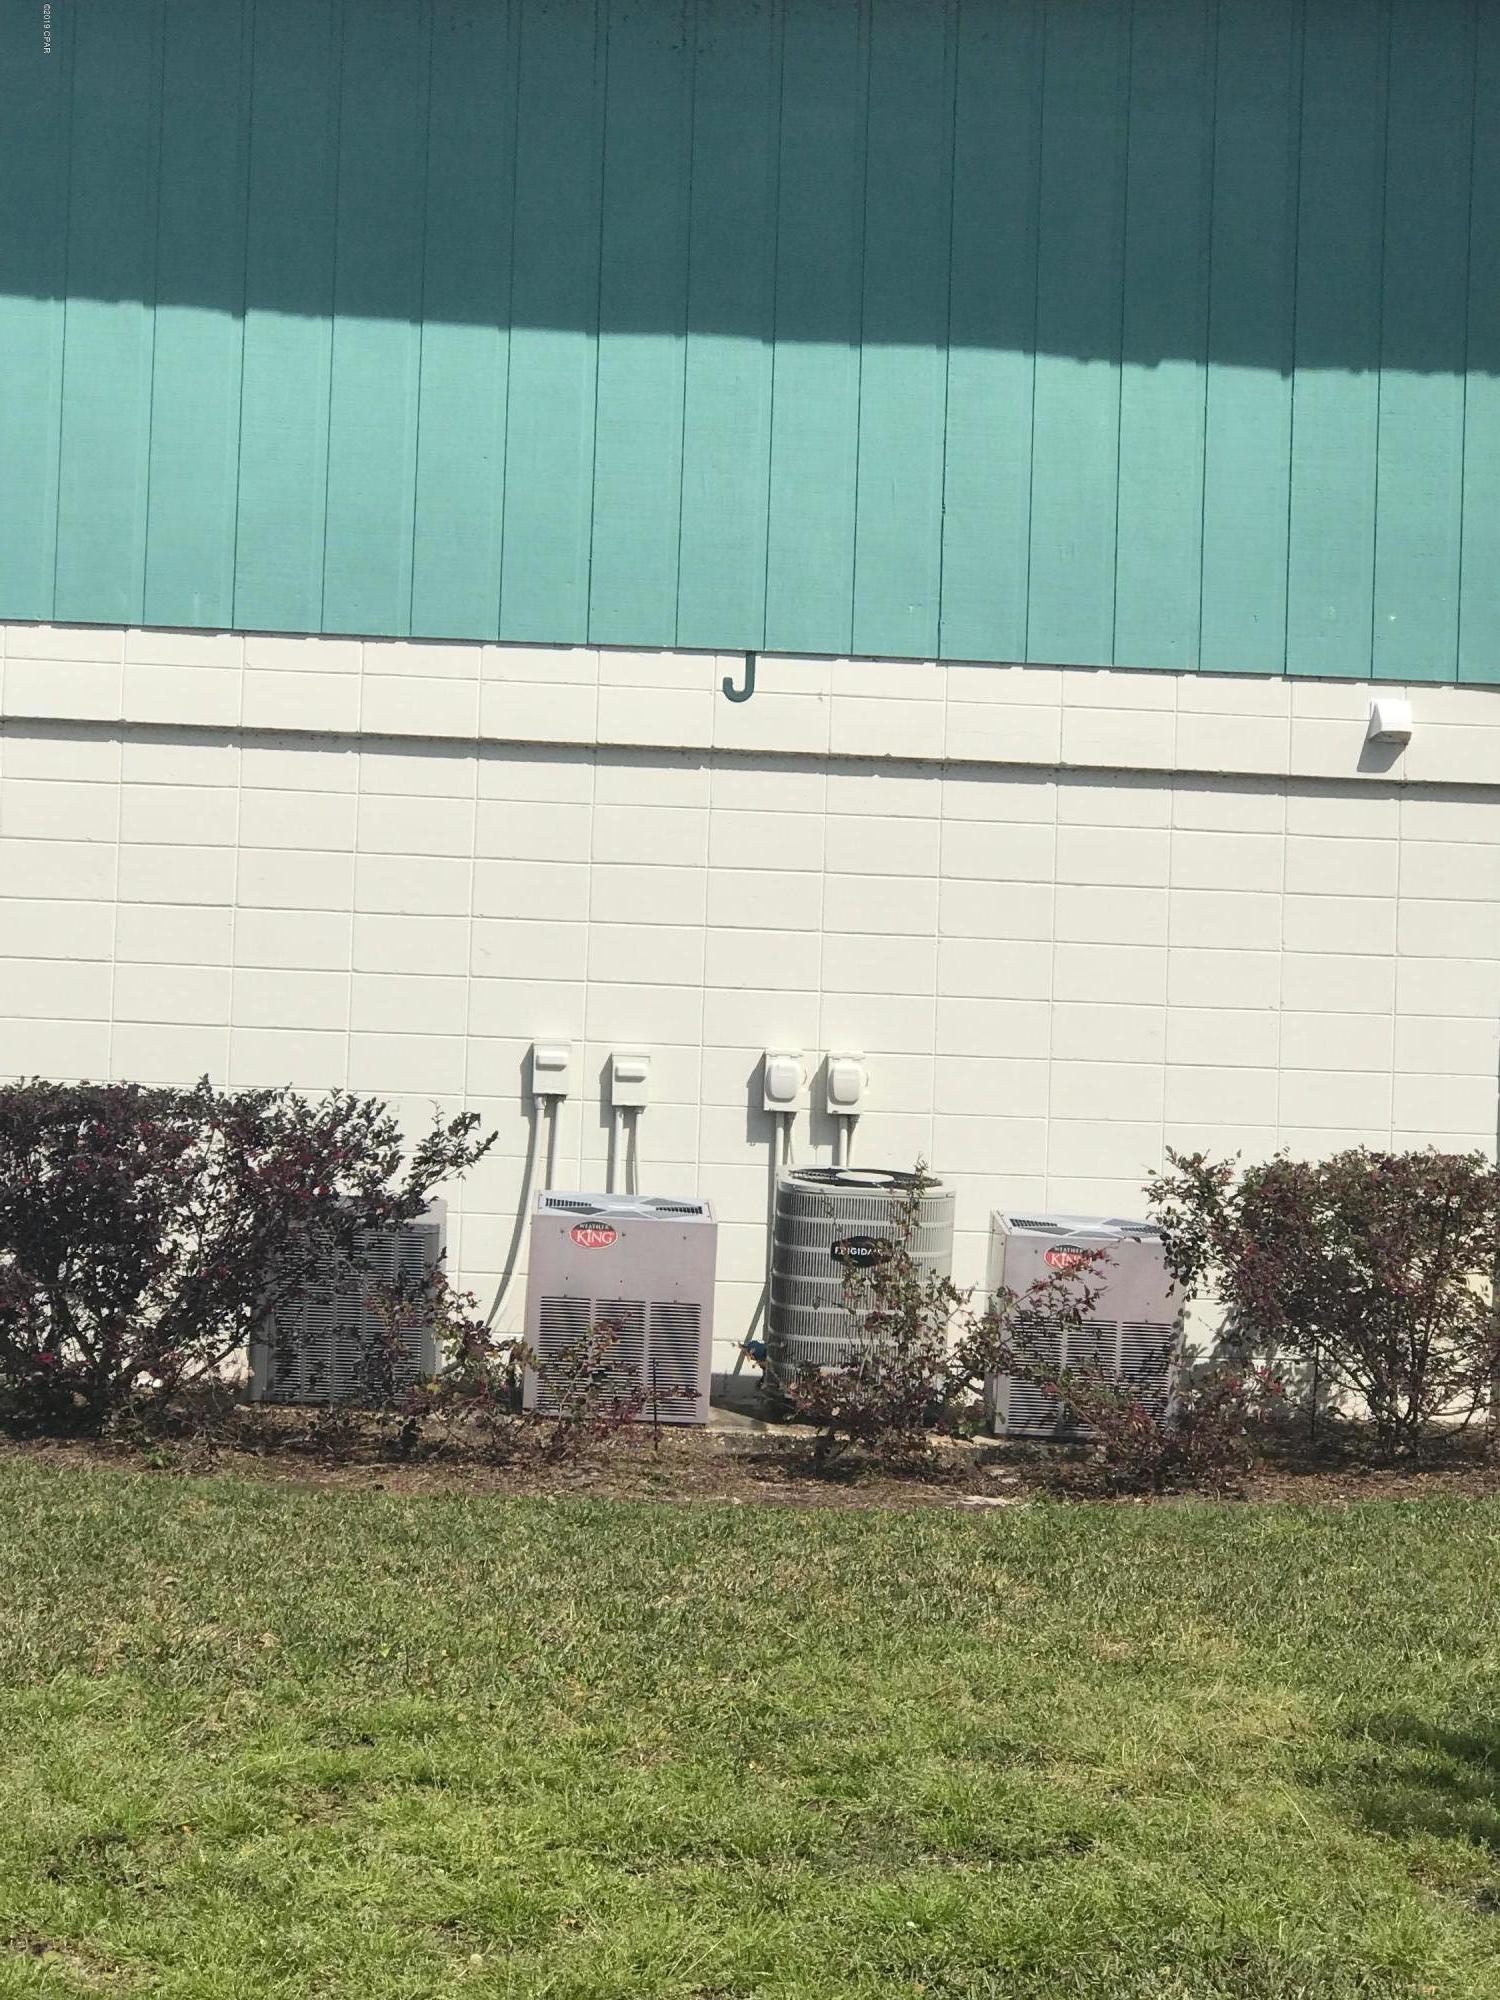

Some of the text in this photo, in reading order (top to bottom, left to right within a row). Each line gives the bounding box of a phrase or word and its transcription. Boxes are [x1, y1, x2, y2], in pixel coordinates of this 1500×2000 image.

[576, 1229, 613, 1246] KING
[834, 1246, 886, 1257] FRIGIDA
[1051, 1253, 1090, 1269] KIN
